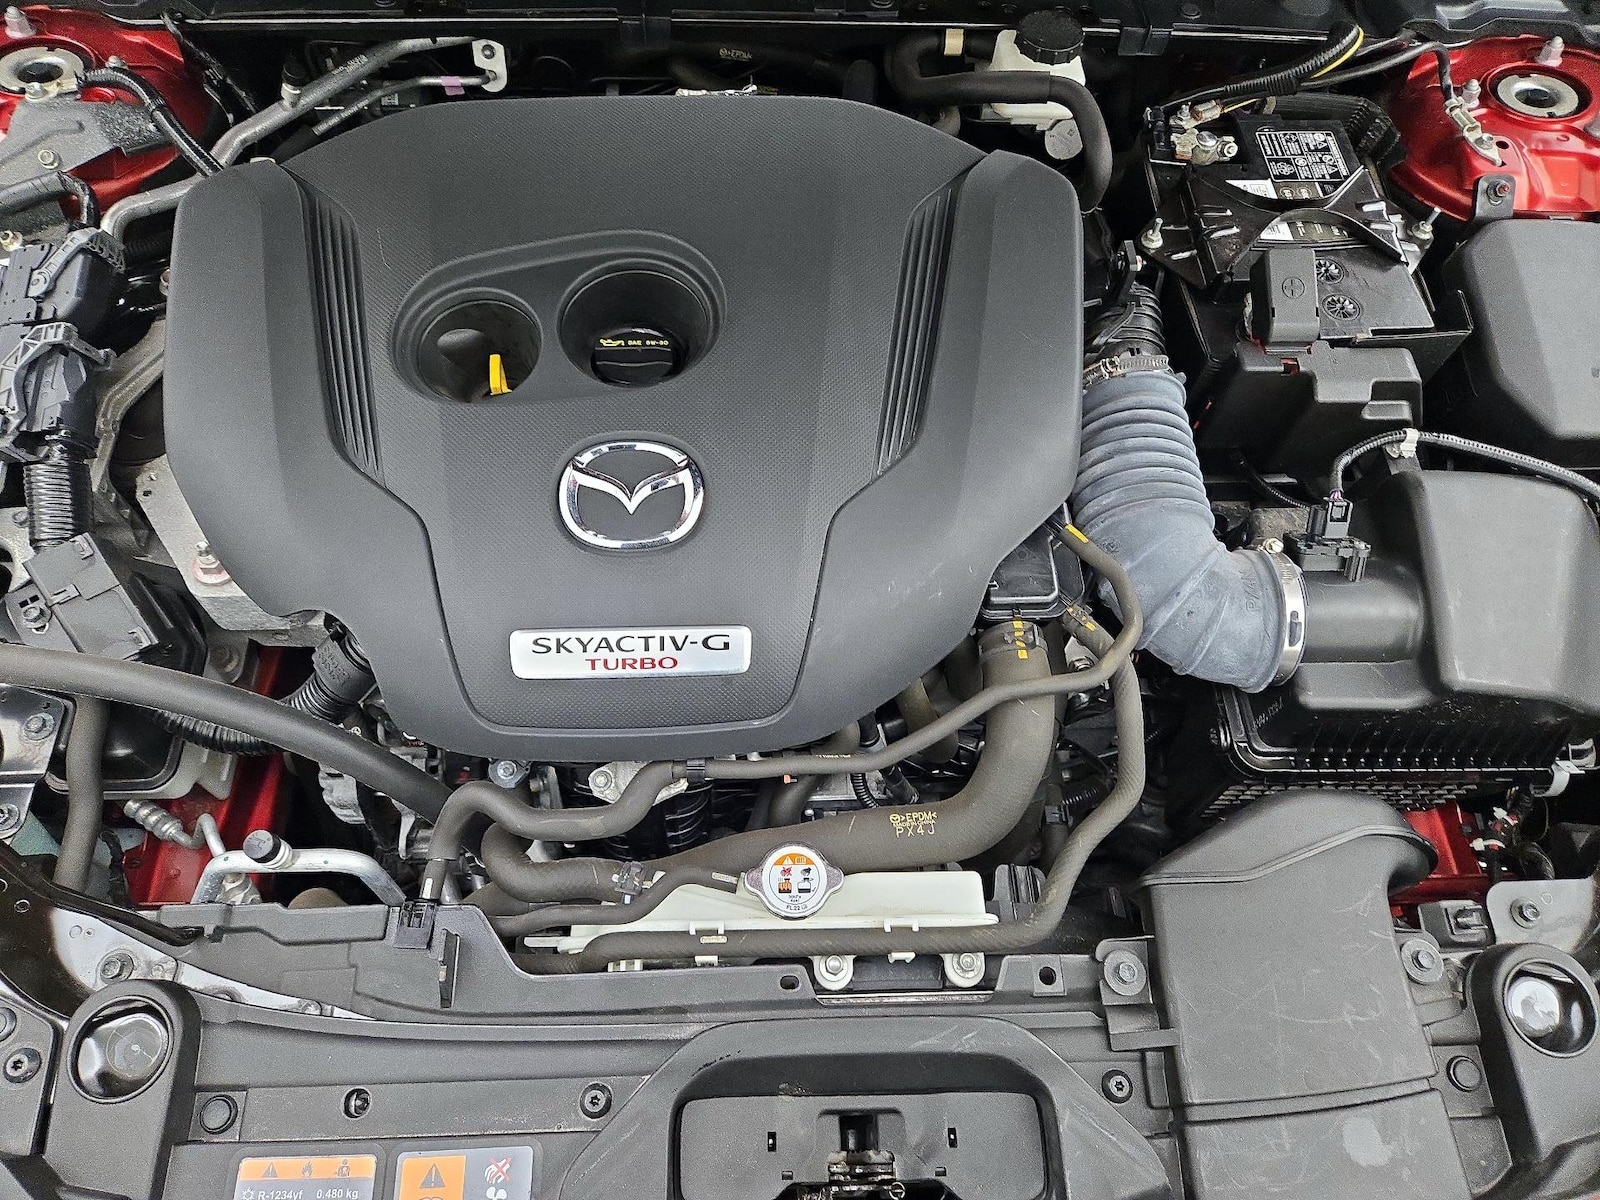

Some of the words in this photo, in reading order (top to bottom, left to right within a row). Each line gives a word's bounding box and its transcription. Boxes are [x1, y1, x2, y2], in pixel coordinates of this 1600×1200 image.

[531, 633, 731, 655] SKYACTIV-G
[584, 656, 679, 671] TURBO
[257, 1189, 304, 1200] R-1234yf
[316, 1188, 343, 1199] 0.480
[345, 1188, 359, 1200] kg
